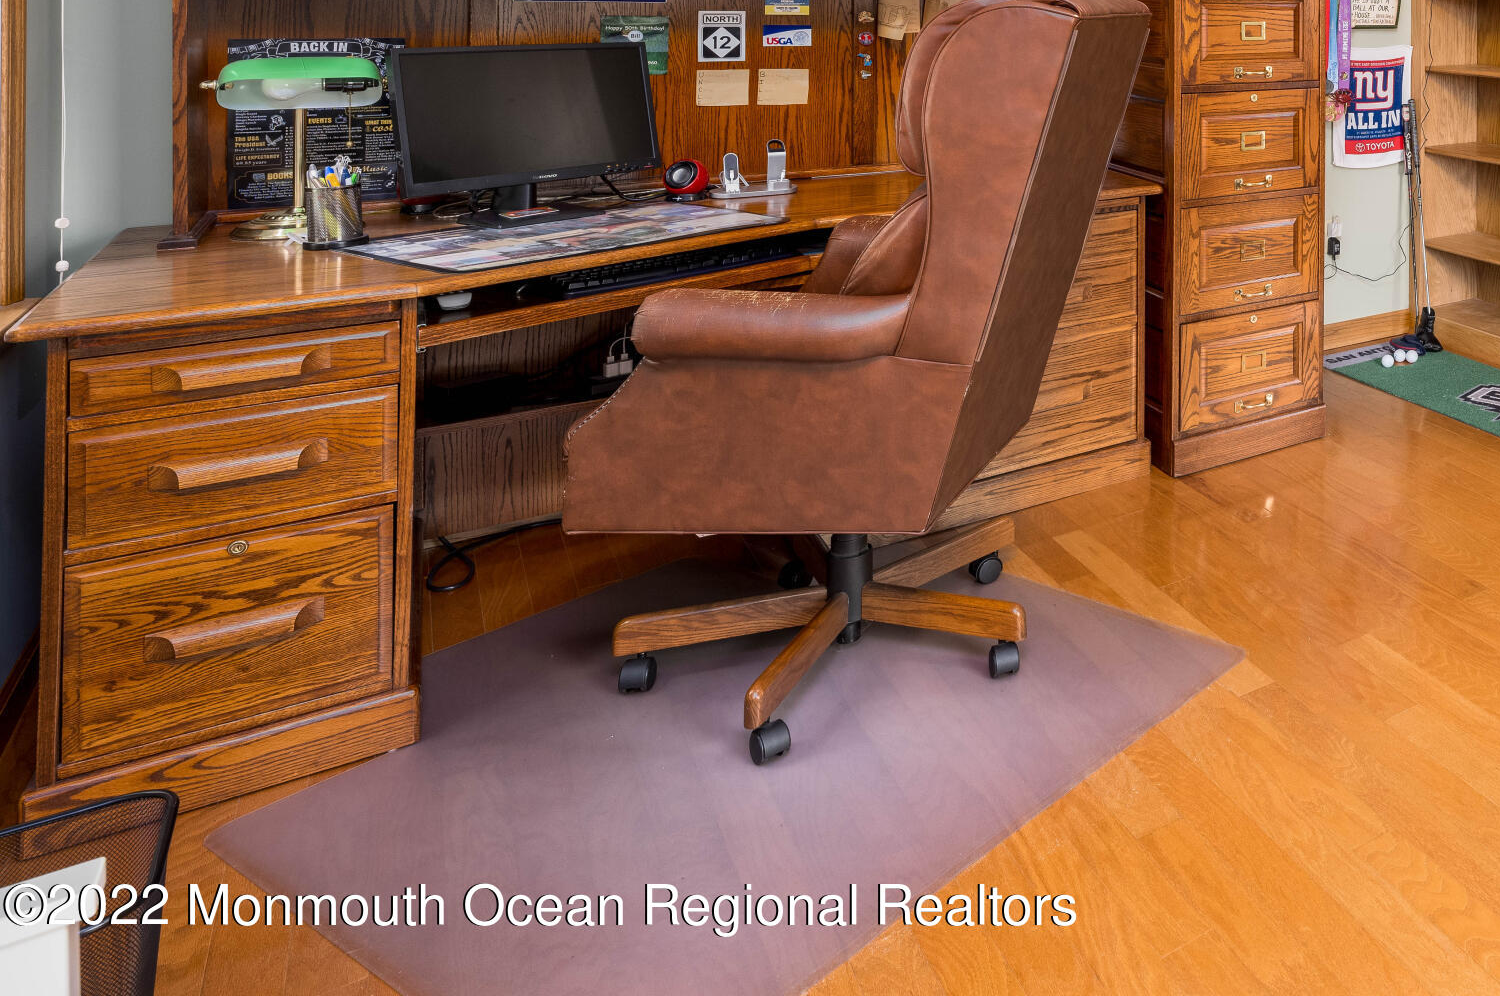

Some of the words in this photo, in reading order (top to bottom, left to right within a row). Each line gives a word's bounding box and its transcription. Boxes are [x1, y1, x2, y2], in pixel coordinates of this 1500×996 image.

[705, 15, 739, 23] NORTH
[712, 35, 731, 50] 12
[766, 37, 793, 45] USGA
[290, 42, 329, 53] BACK
[333, 42, 349, 53] IN
[1346, 112, 1379, 130] ALL
[1380, 109, 1401, 129] IN
[1365, 141, 1395, 151] TOYOTA
[267, 172, 294, 180] BOOKS
[1326, 353, 1358, 364] SAN
